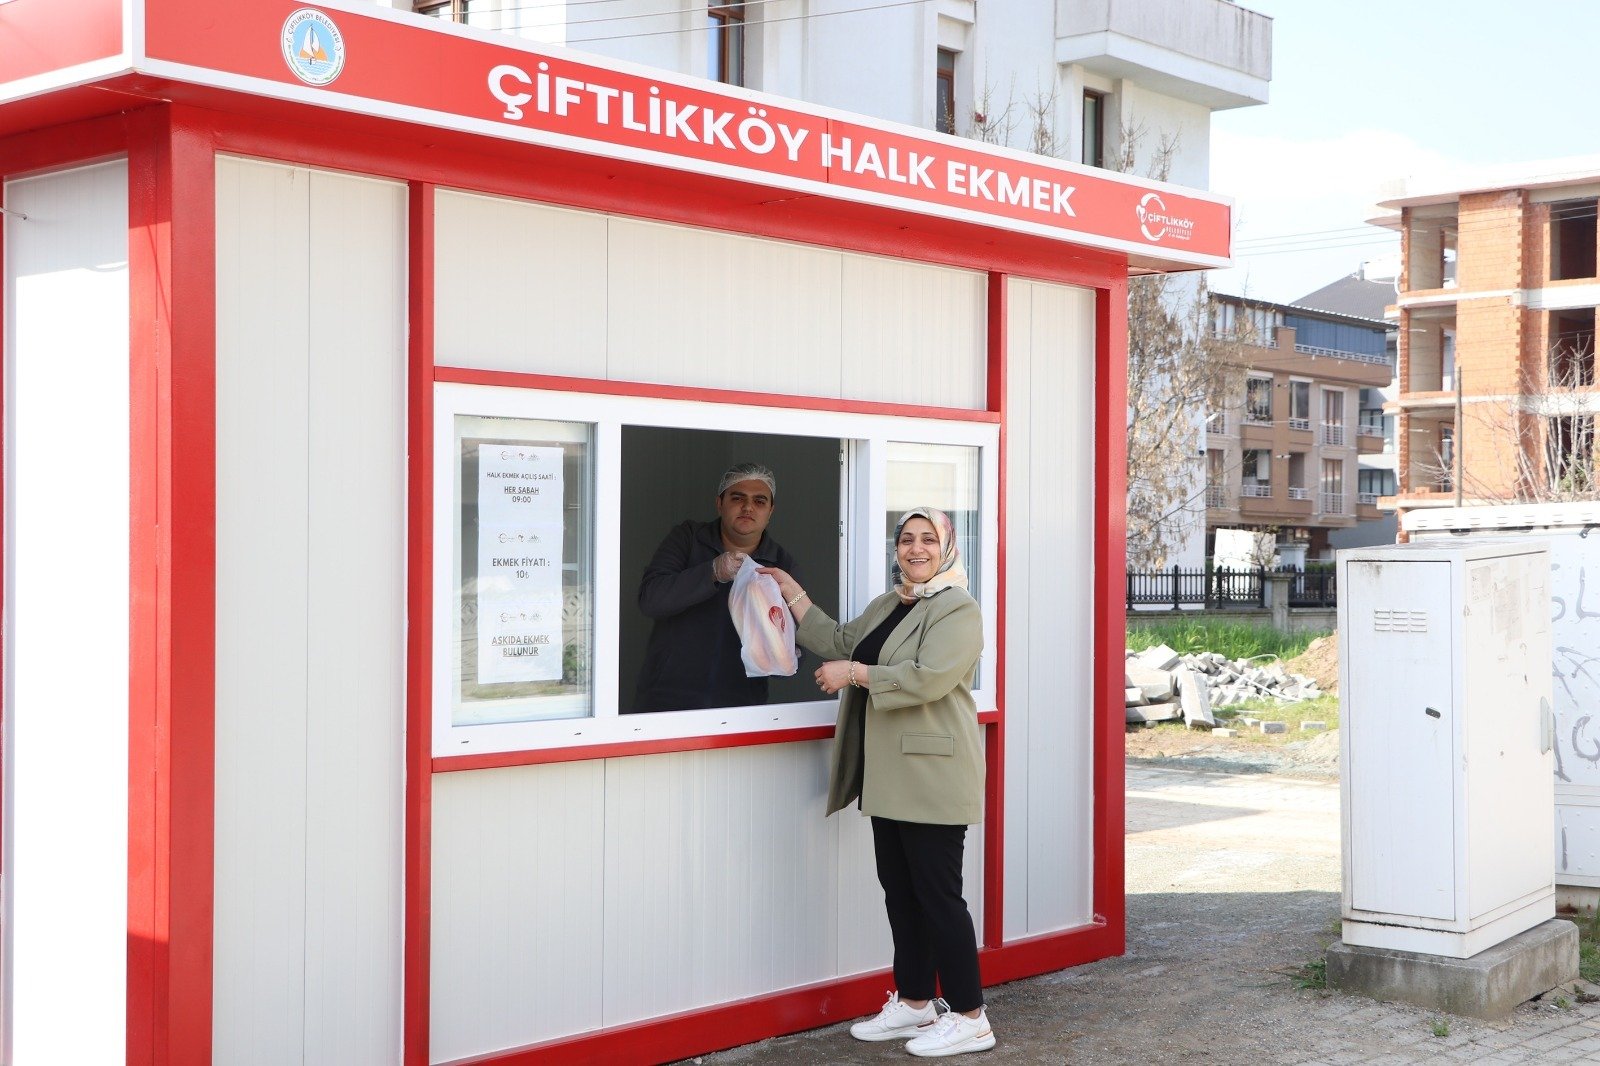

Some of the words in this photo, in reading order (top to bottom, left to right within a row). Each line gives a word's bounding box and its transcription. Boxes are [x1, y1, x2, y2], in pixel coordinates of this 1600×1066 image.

[487, 61, 810, 162] ÇİFTLİKKÖY
[821, 133, 936, 190] HALK
[947, 160, 1077, 218] EKMEK
[1148, 213, 1194, 229] ÇİFTLİKKÖY
[486, 471, 501, 479] HALK
[521, 473, 538, 481] AÇILIŞ
[504, 486, 516, 494] HER
[518, 486, 540, 494] SABAH
[512, 495, 532, 504] 09:00
[492, 557, 520, 567] EKMEK
[521, 556, 546, 567] FİYATI
[491, 635, 522, 646] ASKIDA
[523, 634, 550, 645] EKMEK
[502, 646, 540, 657] BULUNUR
